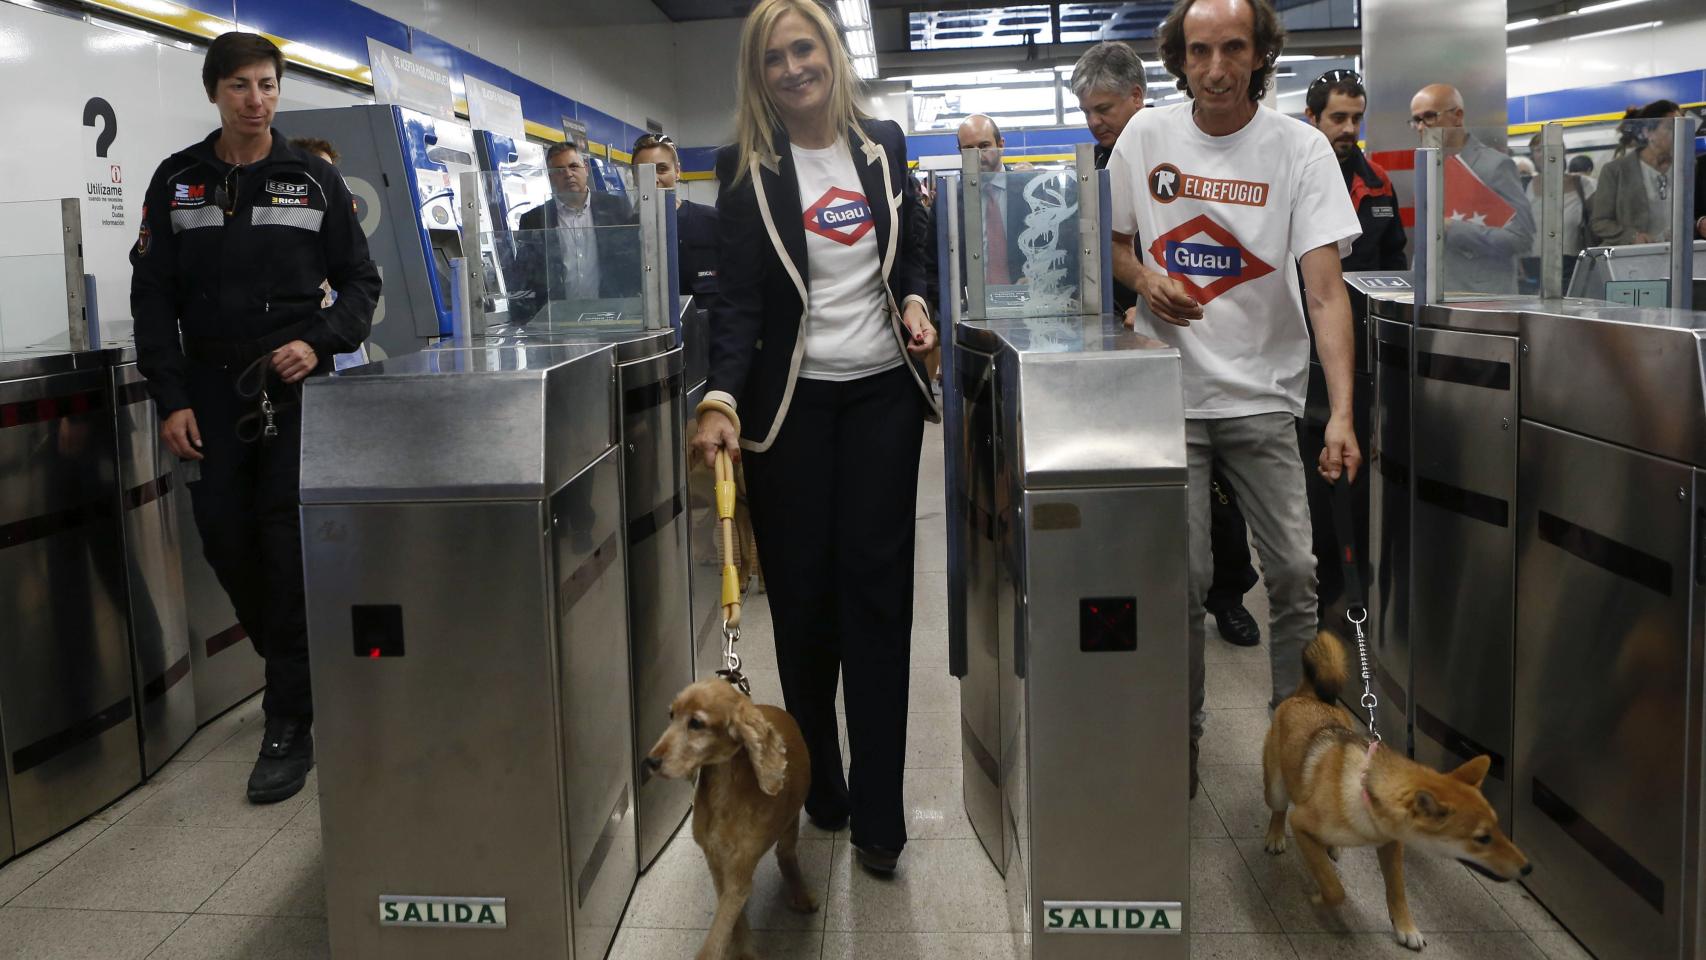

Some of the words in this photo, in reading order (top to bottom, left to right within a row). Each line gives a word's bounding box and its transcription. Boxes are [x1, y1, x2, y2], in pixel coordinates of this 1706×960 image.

[823, 207, 865, 224] Guau
[1174, 247, 1231, 269] Guau
[384, 902, 497, 924] SALIDA
[1048, 908, 1171, 929] SALIDA
